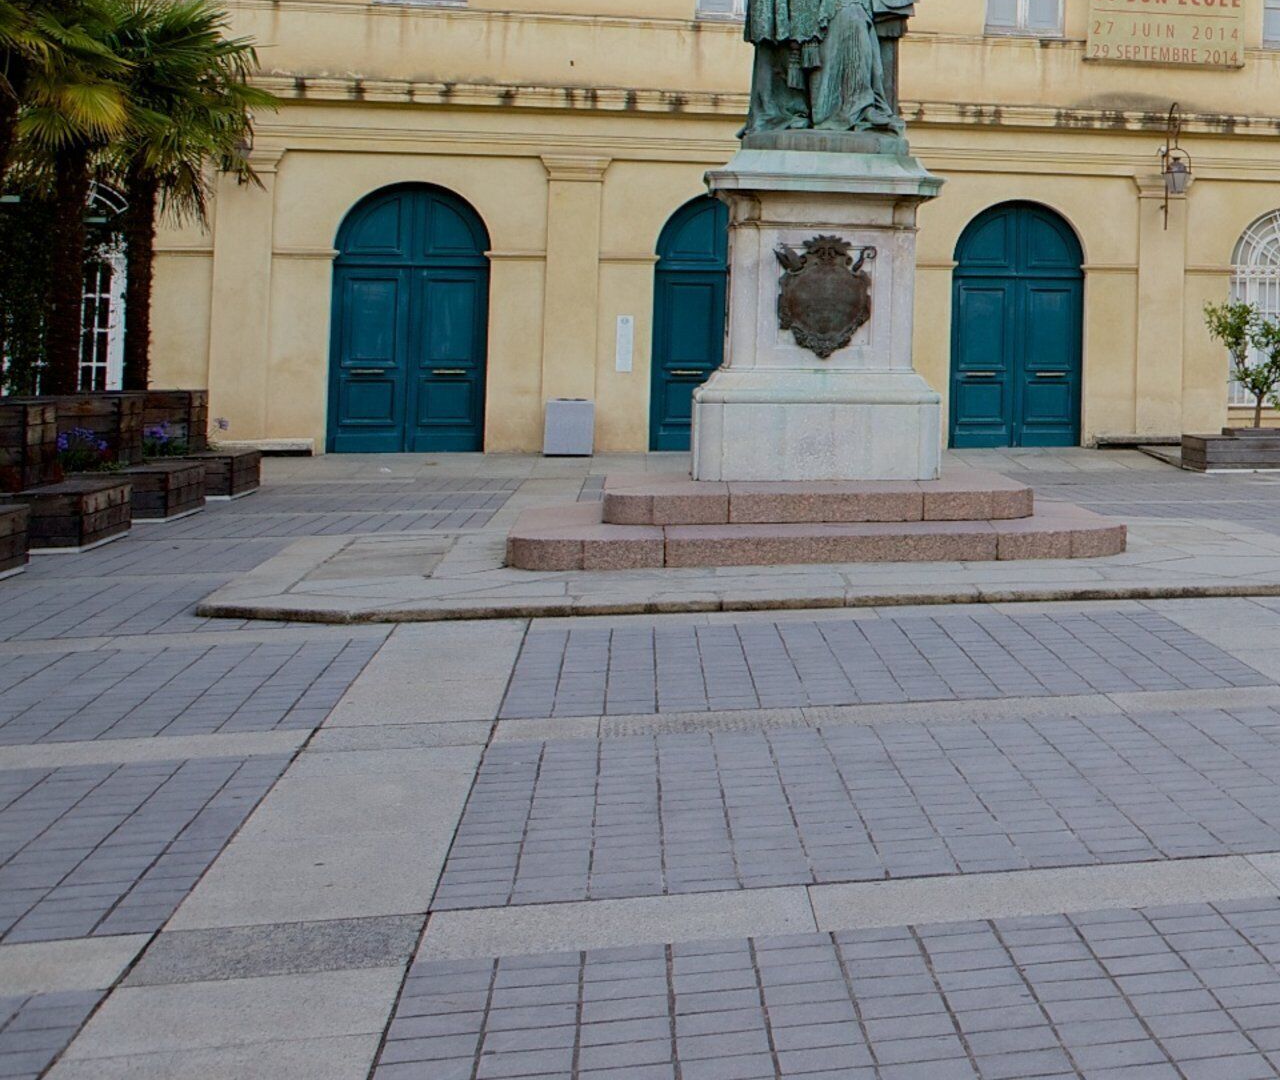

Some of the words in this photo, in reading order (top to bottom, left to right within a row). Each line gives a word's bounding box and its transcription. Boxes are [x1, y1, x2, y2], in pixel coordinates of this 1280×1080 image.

[1093, 20, 1114, 35] 27
[1131, 22, 1175, 38] JUIN
[1192, 26, 1239, 41] 2014
[1093, 44, 1110, 58] 29
[1116, 44, 1197, 63] SEPTEMBRE
[1204, 49, 1239, 65] 2014
